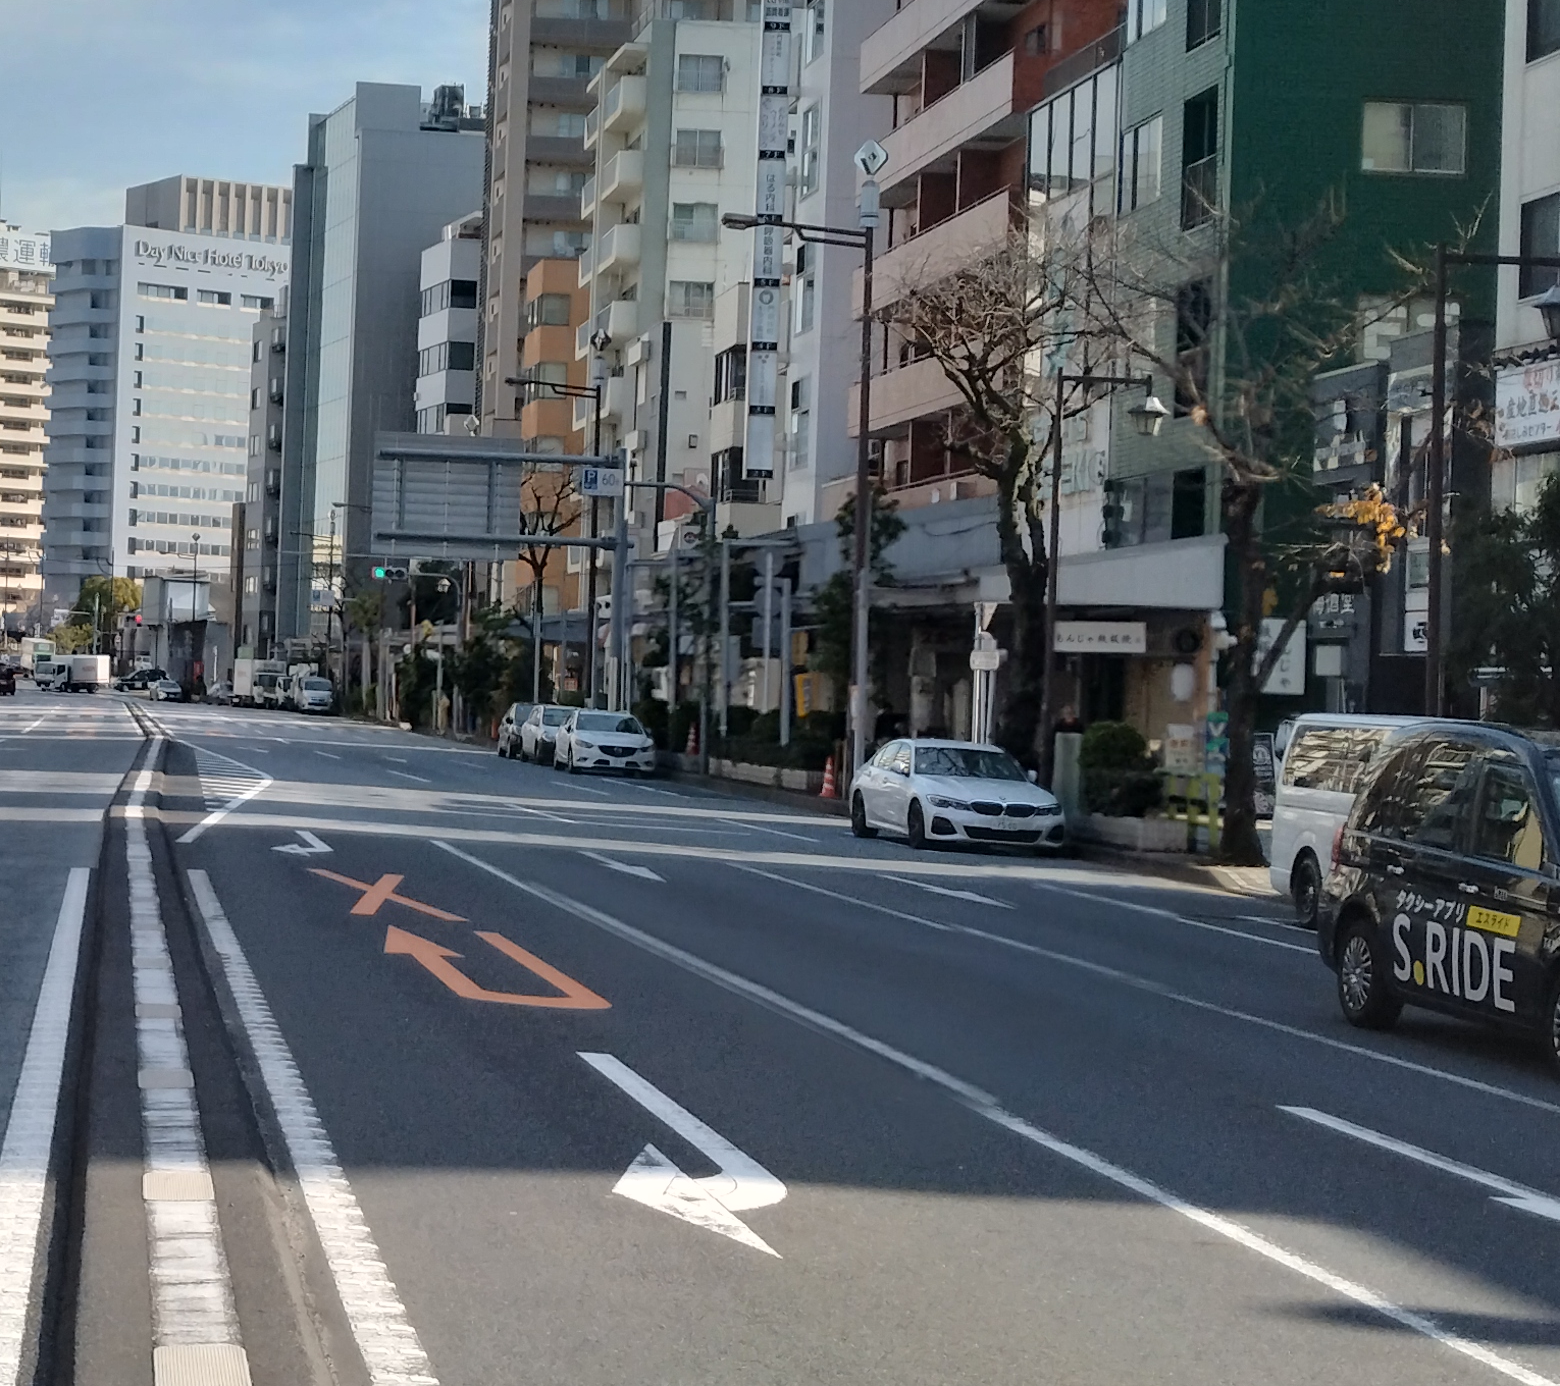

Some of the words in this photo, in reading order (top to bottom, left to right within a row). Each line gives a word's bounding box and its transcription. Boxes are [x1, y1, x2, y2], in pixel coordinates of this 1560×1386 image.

[135, 239, 166, 263] Day
[167, 243, 203, 263] Nice
[203, 248, 245, 268] Hotel
[246, 254, 289, 277] Tokyo
[1395, 889, 1465, 923] タクシーアプリ
[1475, 911, 1512, 929] エスライド
[1392, 912, 1517, 1013] S.RIDE
